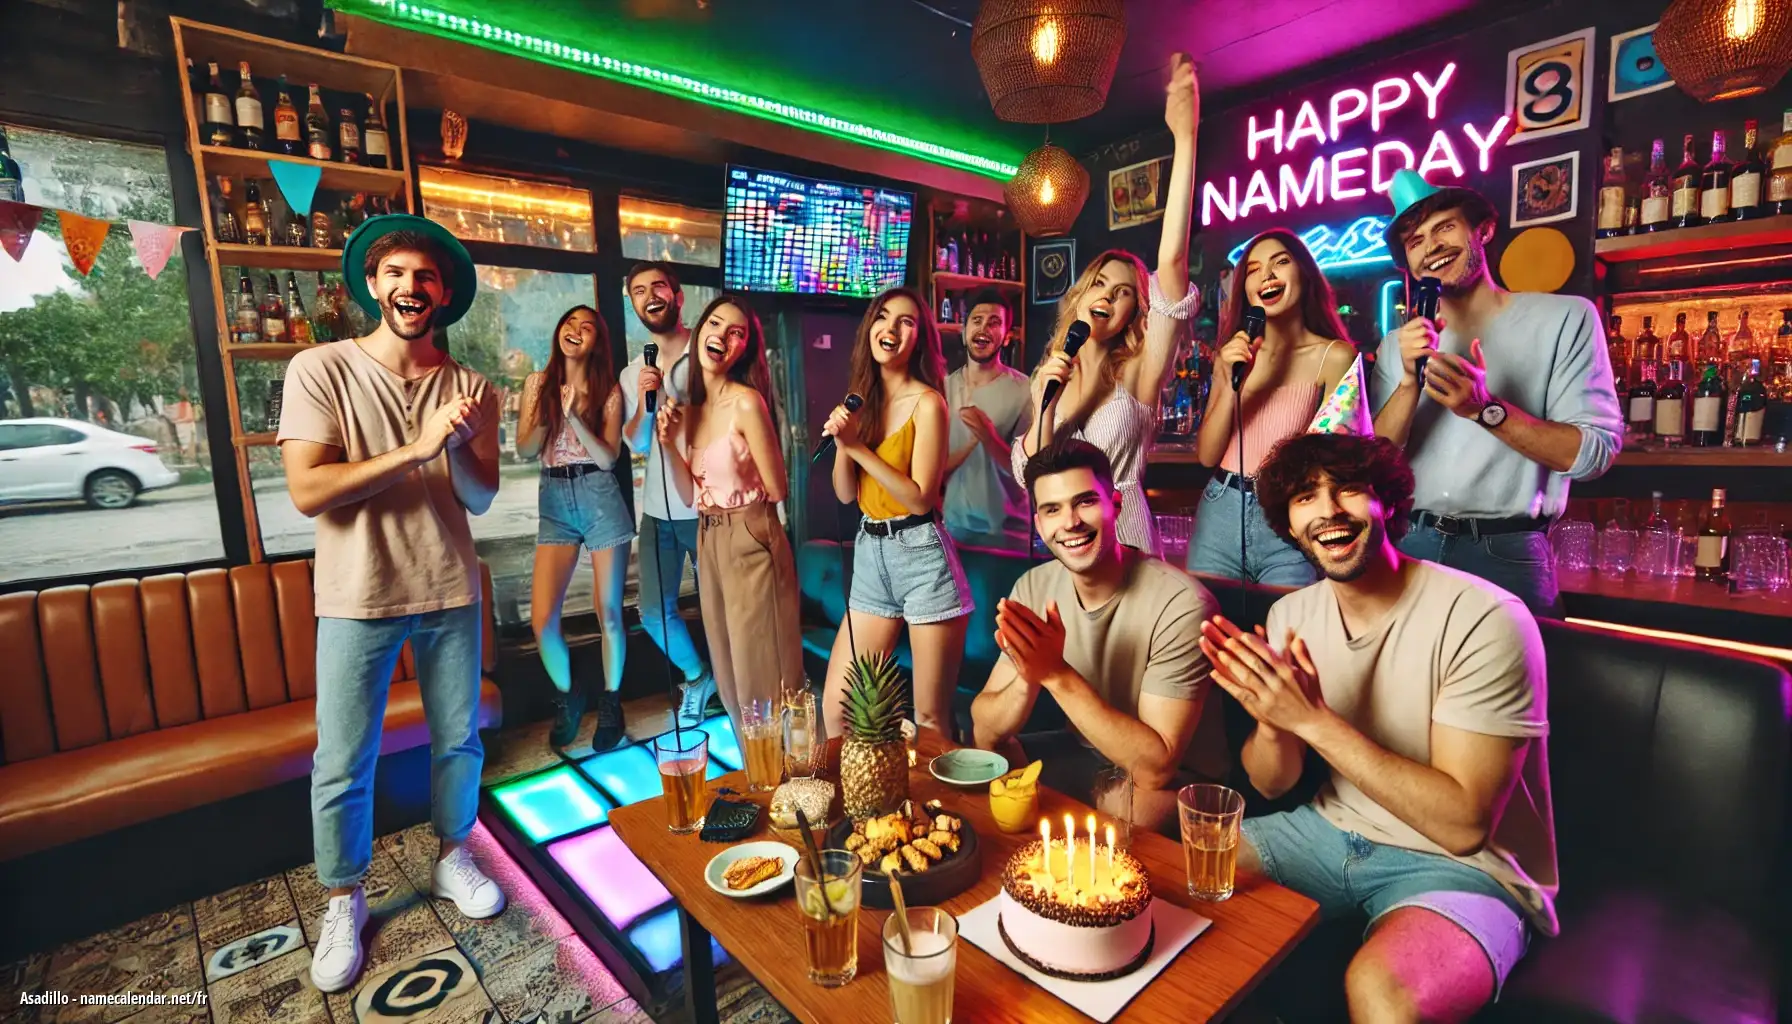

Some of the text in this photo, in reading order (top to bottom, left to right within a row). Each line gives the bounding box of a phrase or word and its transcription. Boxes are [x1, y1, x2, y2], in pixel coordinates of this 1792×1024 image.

[1247, 62, 1456, 161] HAPPY
[1524, 61, 1573, 122] 8
[1202, 115, 1511, 226] NAMEDAY
